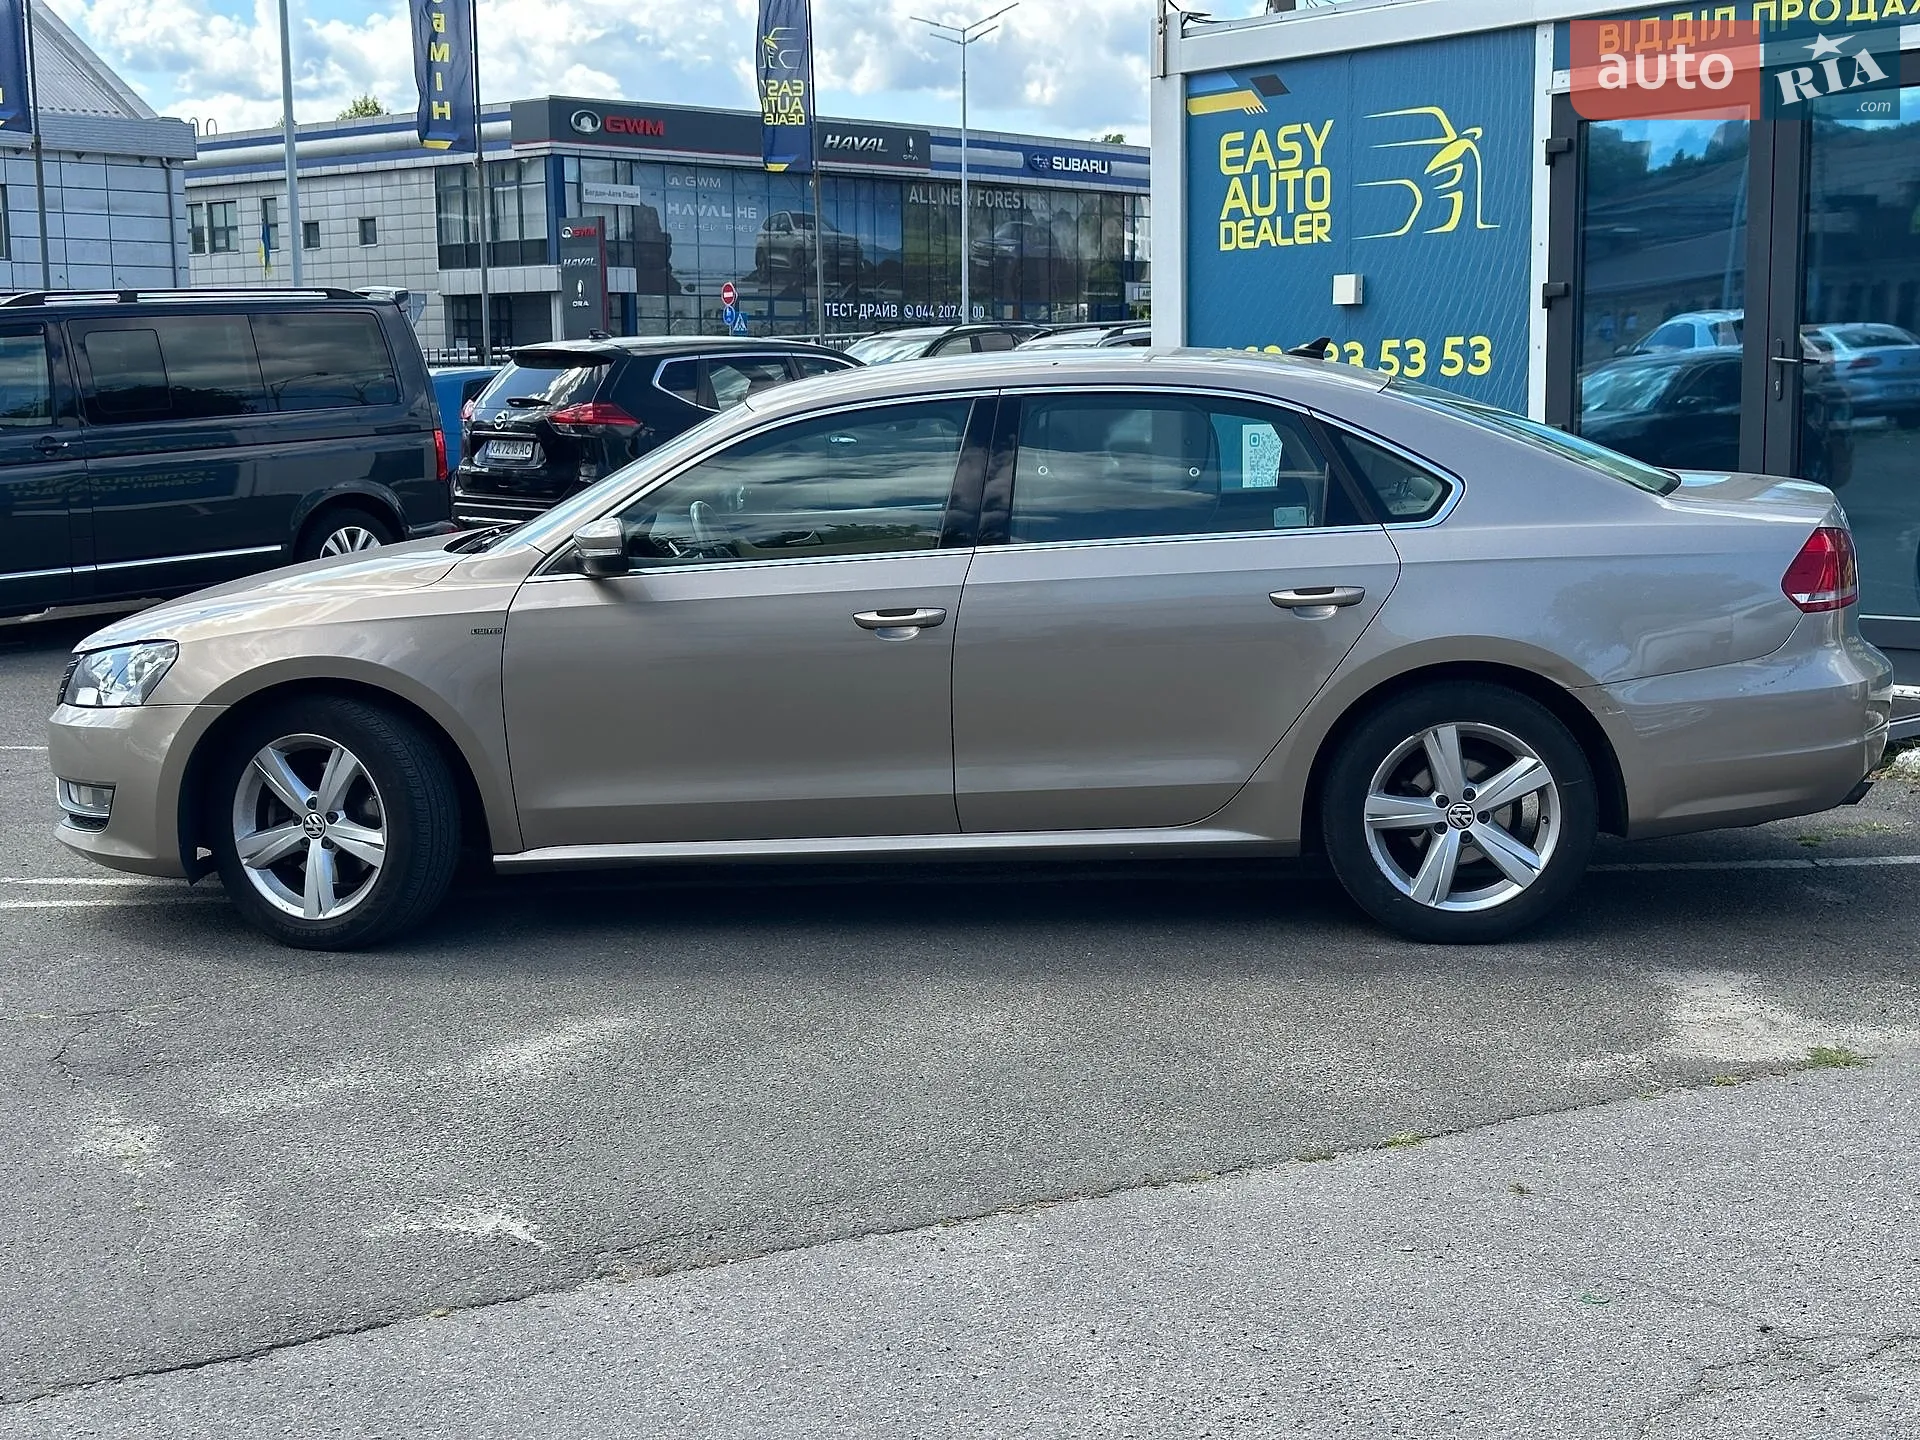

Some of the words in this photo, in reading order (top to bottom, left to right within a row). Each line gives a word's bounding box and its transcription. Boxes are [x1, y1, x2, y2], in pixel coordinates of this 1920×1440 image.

[1598, 6, 1736, 54] ВІДДІЛ
[604, 115, 664, 136] GWM
[823, 134, 888, 153] HAVAL
[1219, 119, 1334, 175] EASY
[1052, 156, 1108, 175] SUBARU
[685, 176, 721, 189] GWM
[908, 185, 937, 206] ALL
[977, 190, 1050, 211] FORESTER
[1219, 166, 1331, 220] AUTO
[666, 202, 732, 218] HAVAL
[737, 206, 758, 219] H6
[1219, 211, 1332, 252] DEALER
[563, 257, 597, 267] HAVAL
[572, 300, 590, 308] ORA
[824, 302, 898, 319] ТЕСТ-ДРАЙВ
[915, 304, 935, 319] 044
[972, 305, 985, 319] 00
[1378, 338, 1427, 378] 53
[1439, 335, 1492, 377] 53
